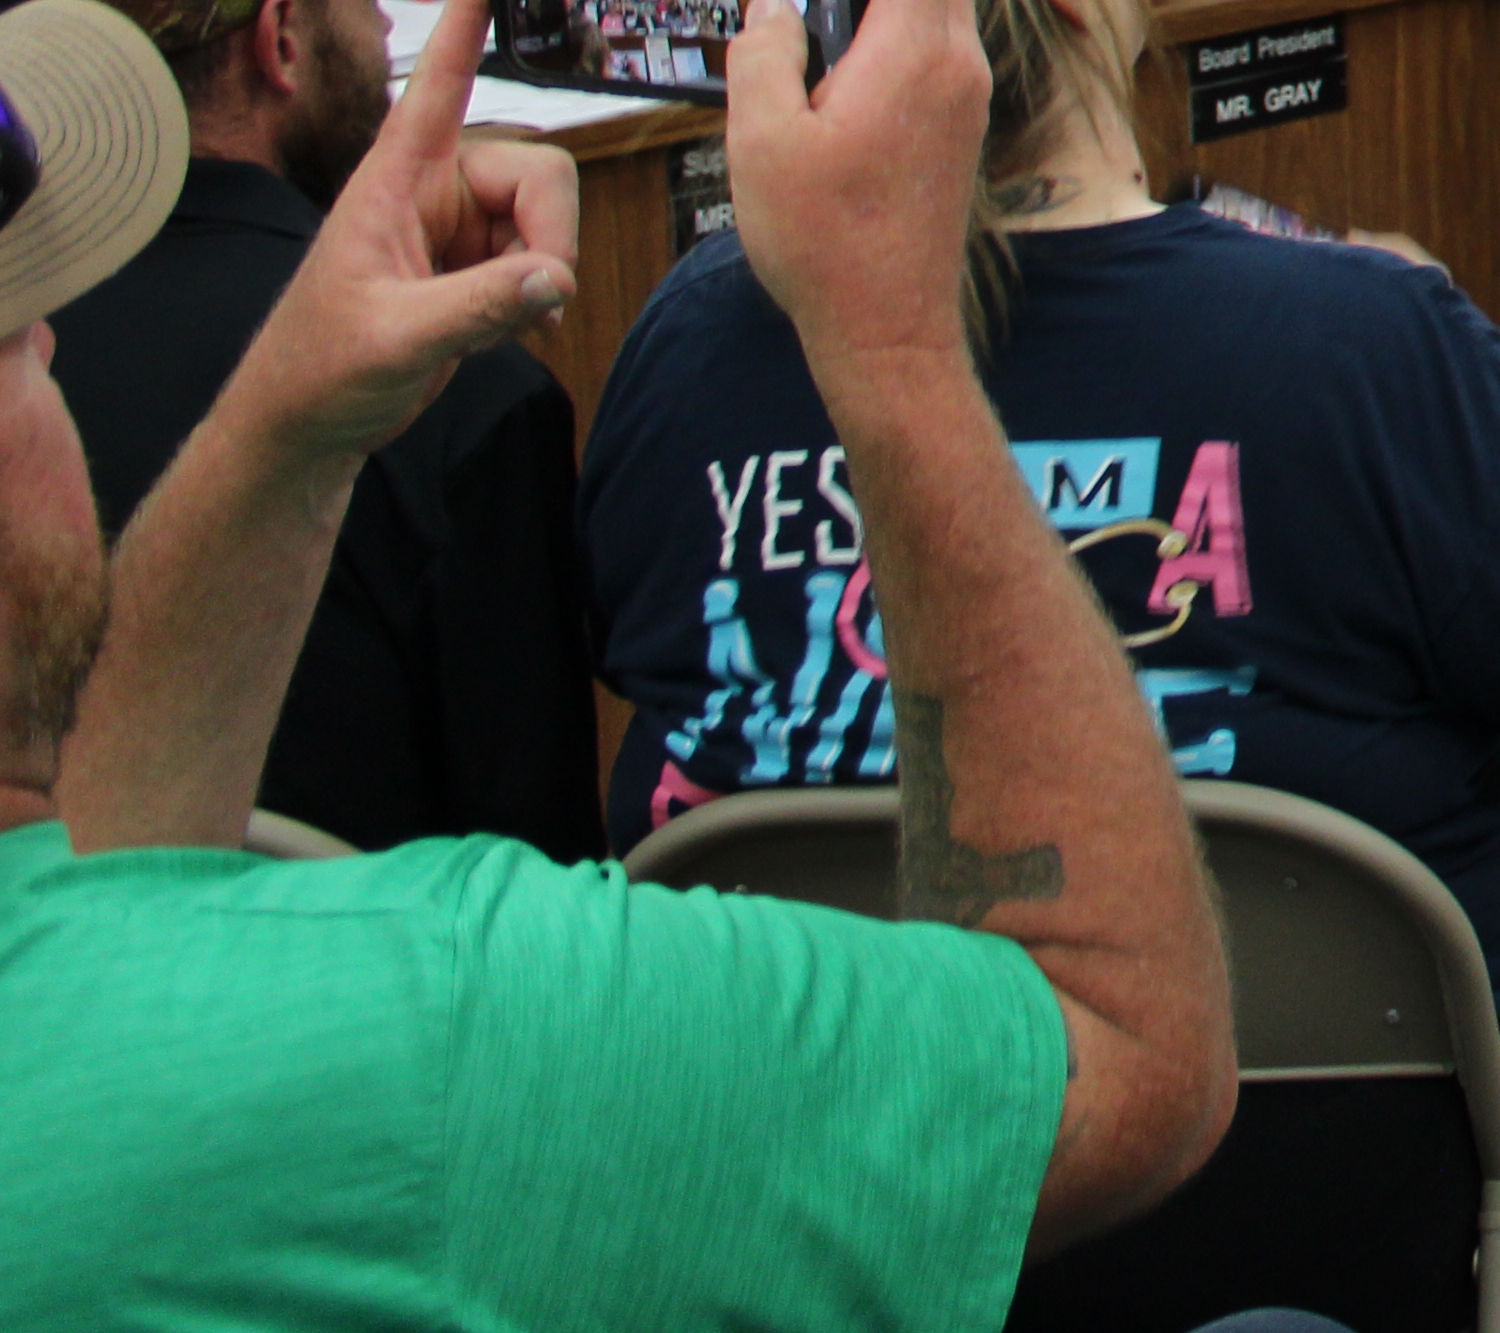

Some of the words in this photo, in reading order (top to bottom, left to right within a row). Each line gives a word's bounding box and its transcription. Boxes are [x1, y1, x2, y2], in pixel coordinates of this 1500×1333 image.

[1199, 40, 1250, 72] Board
[1257, 25, 1335, 59] President
[1216, 94, 1255, 123] MR.
[1264, 78, 1322, 112] GRAY
